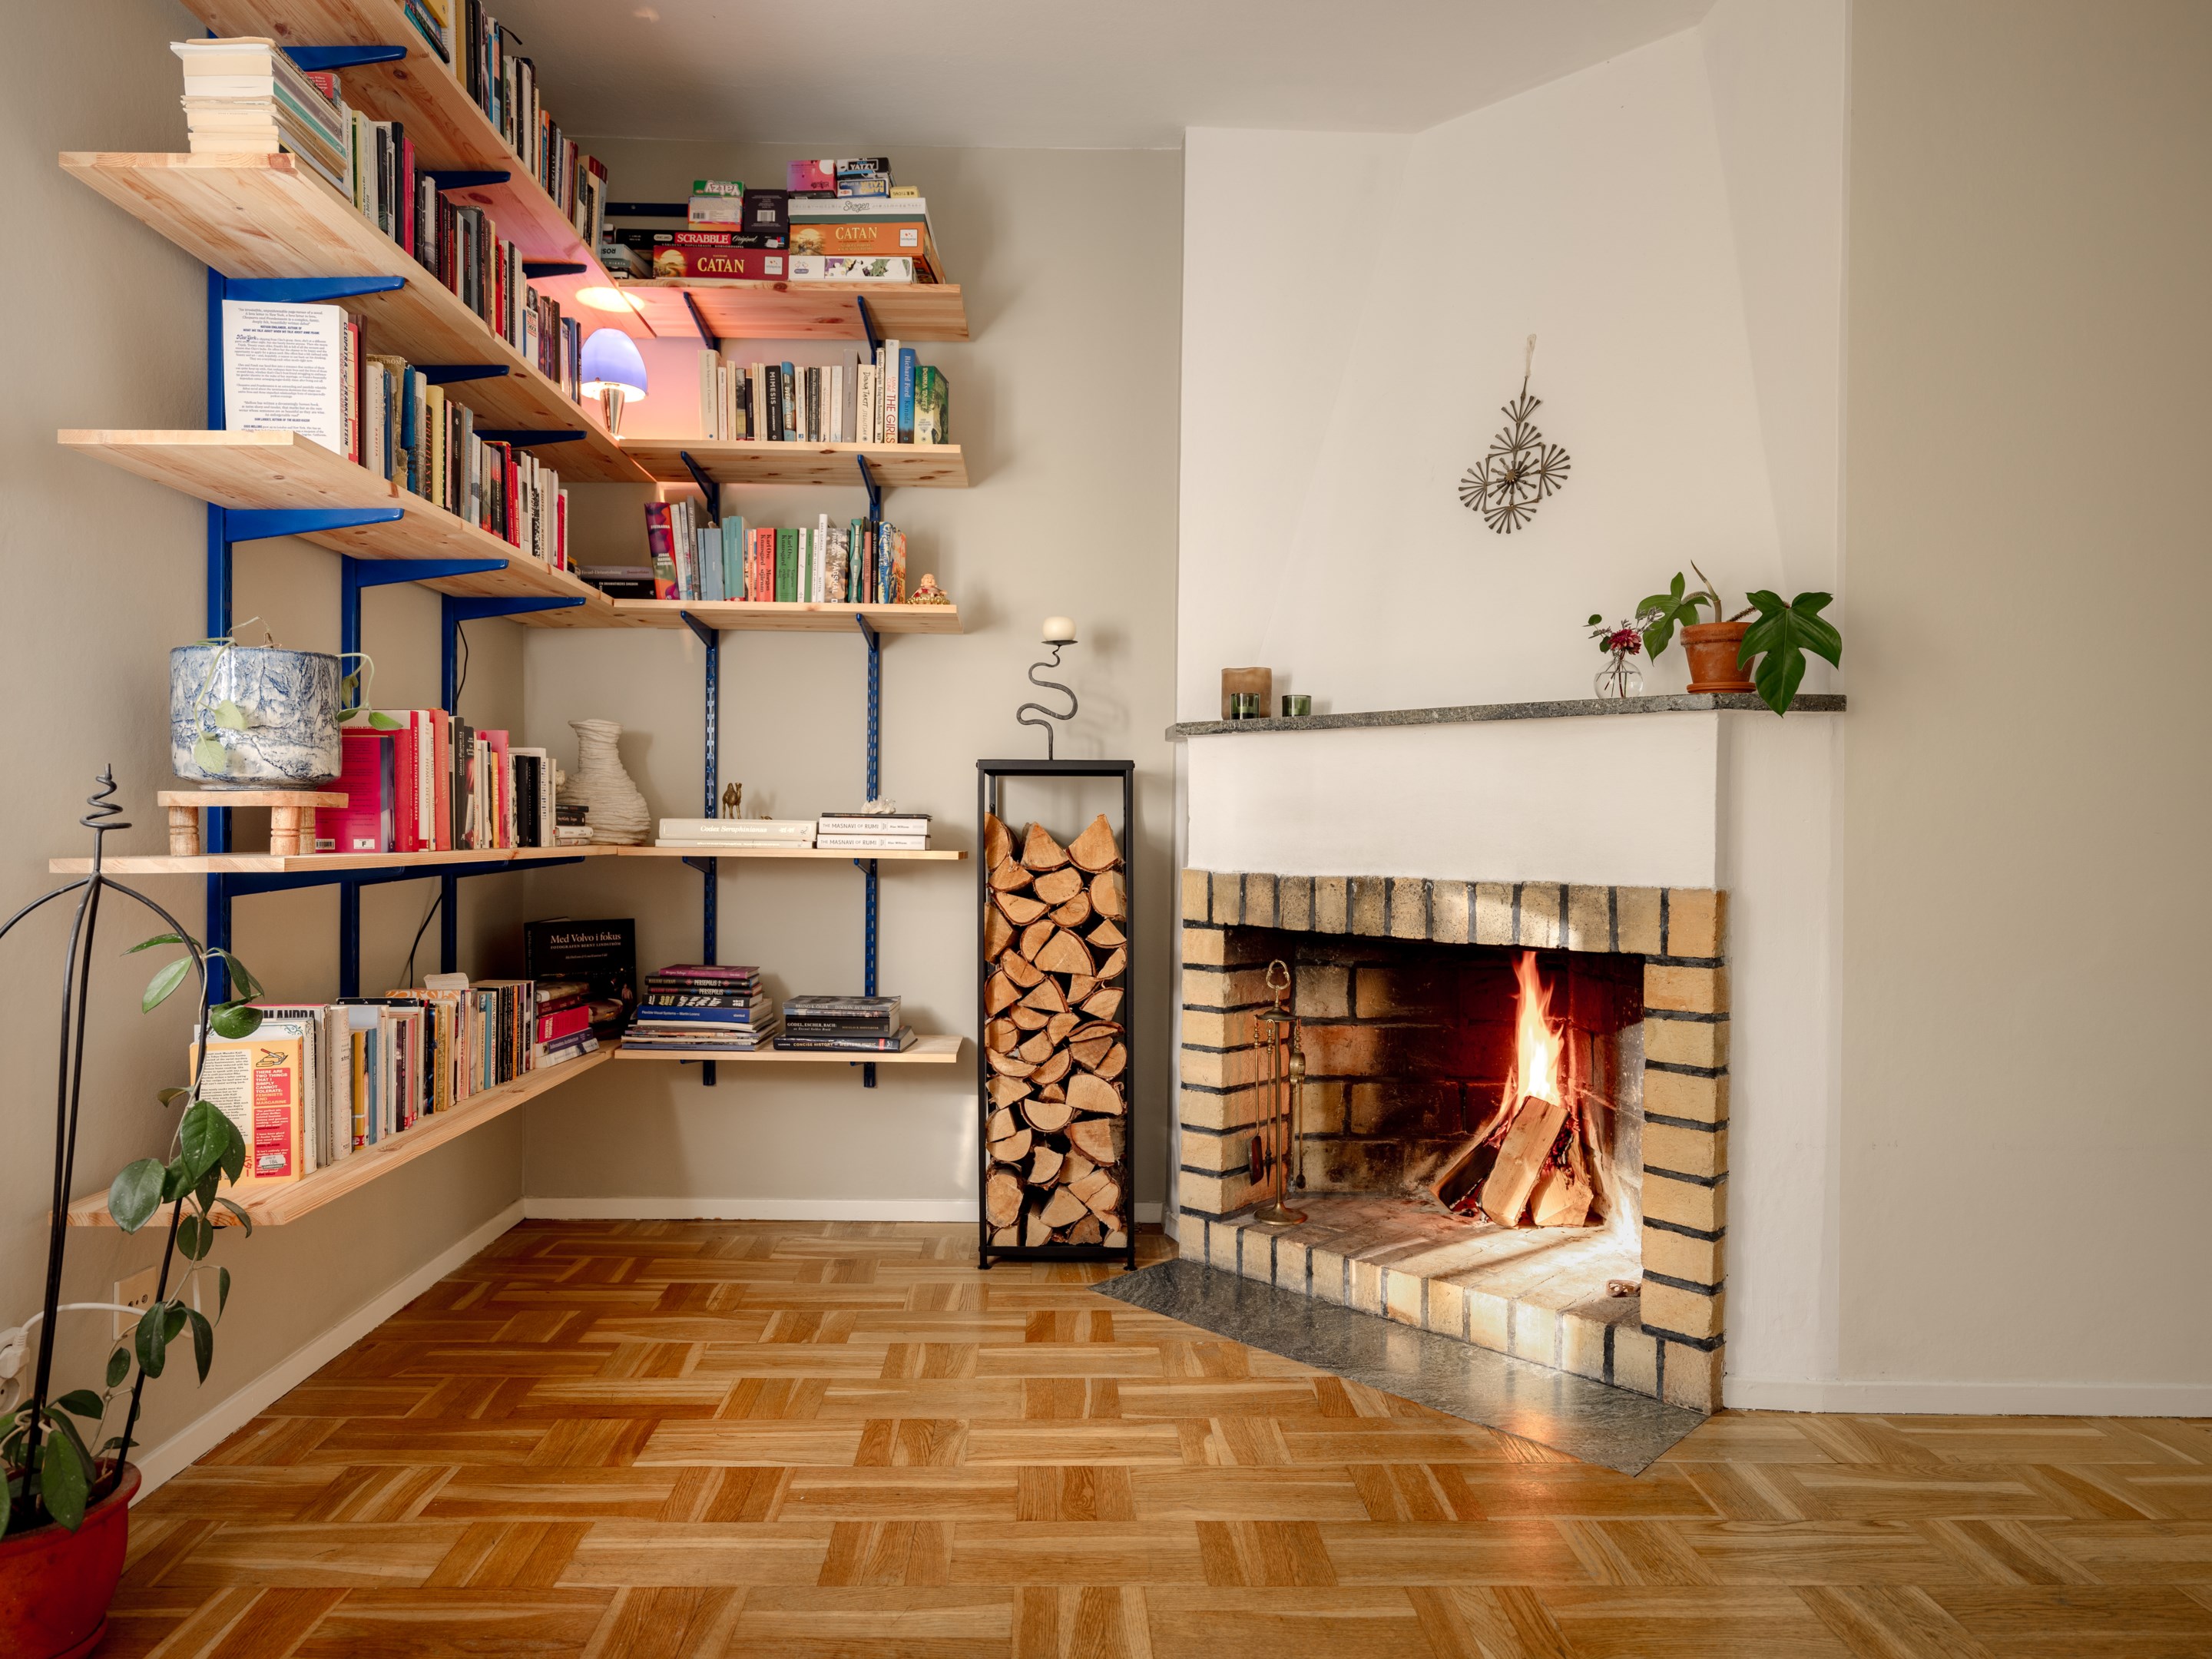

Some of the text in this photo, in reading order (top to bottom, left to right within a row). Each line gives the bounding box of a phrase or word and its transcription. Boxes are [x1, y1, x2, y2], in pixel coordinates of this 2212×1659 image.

[705, 180, 740, 196] Yatzy
[843, 201, 869, 213] Skogen
[677, 233, 728, 243] SCRABBLE
[732, 235, 757, 245] Original
[835, 227, 877, 240] CATAN
[697, 257, 745, 273] CATAN
[863, 372, 871, 389] DONNA
[862, 390, 870, 408] TARTT
[886, 395, 896, 412] THE
[886, 414, 896, 444] GIRLS
[720, 826, 767, 834] Seraphinianus
[551, 934, 569, 944] Med
[571, 932, 594, 943] Volvo
[600, 932, 621, 941] fokus
